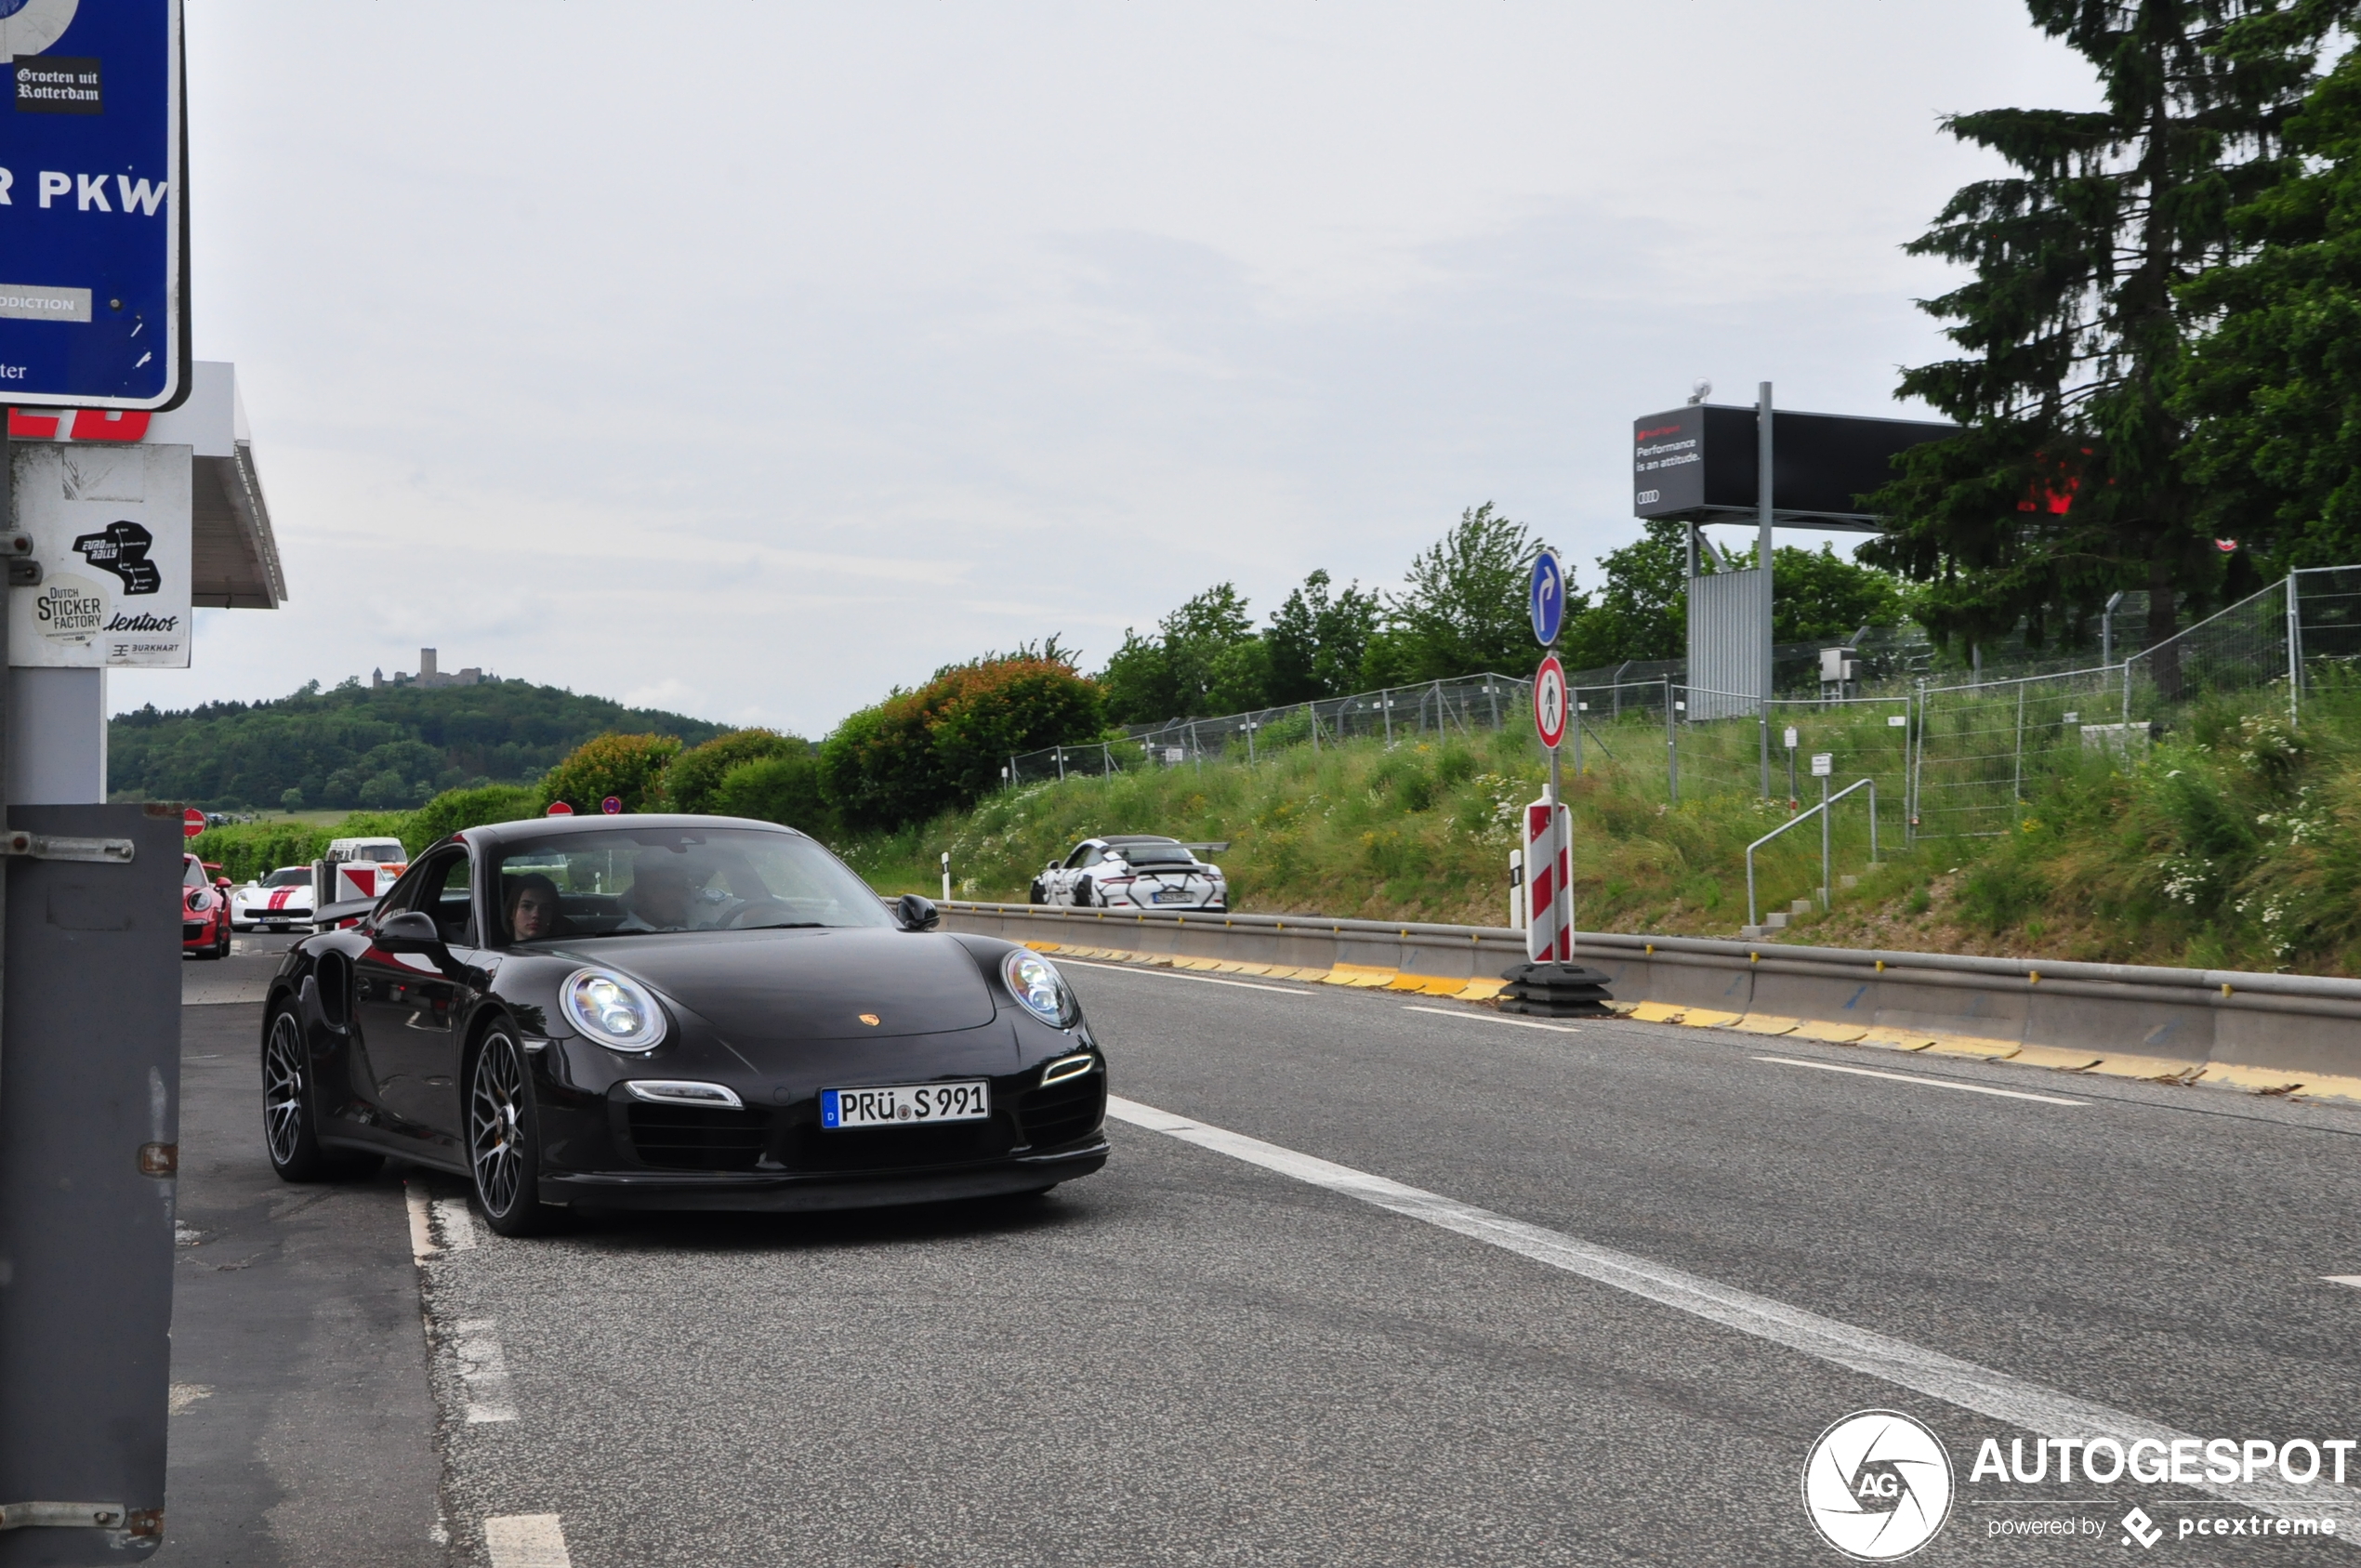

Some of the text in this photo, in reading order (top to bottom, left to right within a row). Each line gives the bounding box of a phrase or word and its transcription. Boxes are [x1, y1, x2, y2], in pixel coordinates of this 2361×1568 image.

[17, 68, 98, 85] Groeten uit
[18, 84, 99, 100] Rotterdam
[39, 170, 168, 217] PKW
[1637, 439, 1696, 457] Performance
[1636, 452, 1701, 471] is an attitude.
[82, 539, 106, 551] EURO
[54, 613, 101, 629] FACTORY
[131, 644, 179, 652] BURKHART
[914, 1089, 930, 1118] S
[937, 1086, 985, 1116] 991
